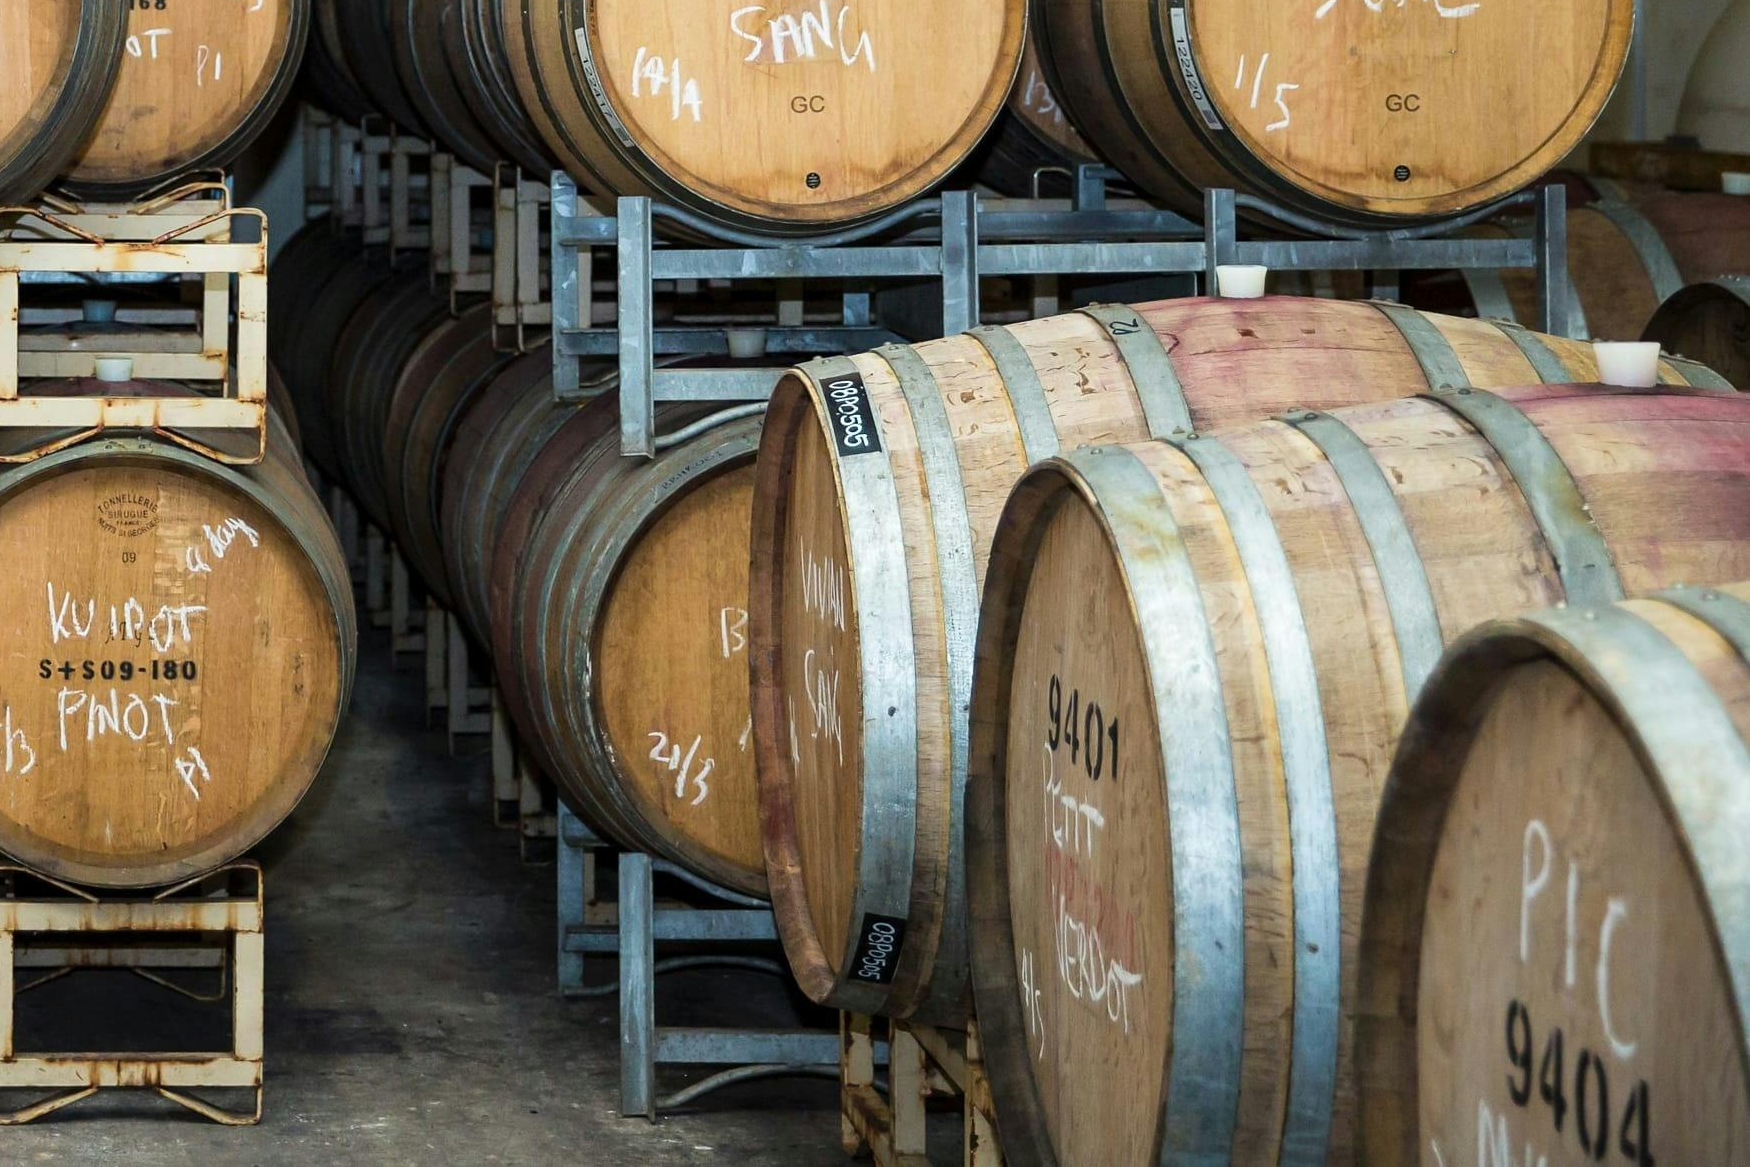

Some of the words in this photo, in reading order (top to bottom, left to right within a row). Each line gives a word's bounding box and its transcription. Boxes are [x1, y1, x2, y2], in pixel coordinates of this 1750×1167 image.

[790, 95, 826, 114] GC
[1385, 93, 1421, 113] GC
[97, 492, 159, 515] TONNELLERIE
[107, 510, 149, 520] SIRUGUE
[121, 551, 137, 564] 09
[38, 657, 197, 682] S+S09-180
[57, 685, 180, 751] PINOT
[1048, 673, 1119, 781] 9401
[1519, 818, 1637, 1060] PIC
[1051, 885, 1143, 1034] VERDOT
[1505, 997, 1655, 1167] 9404
